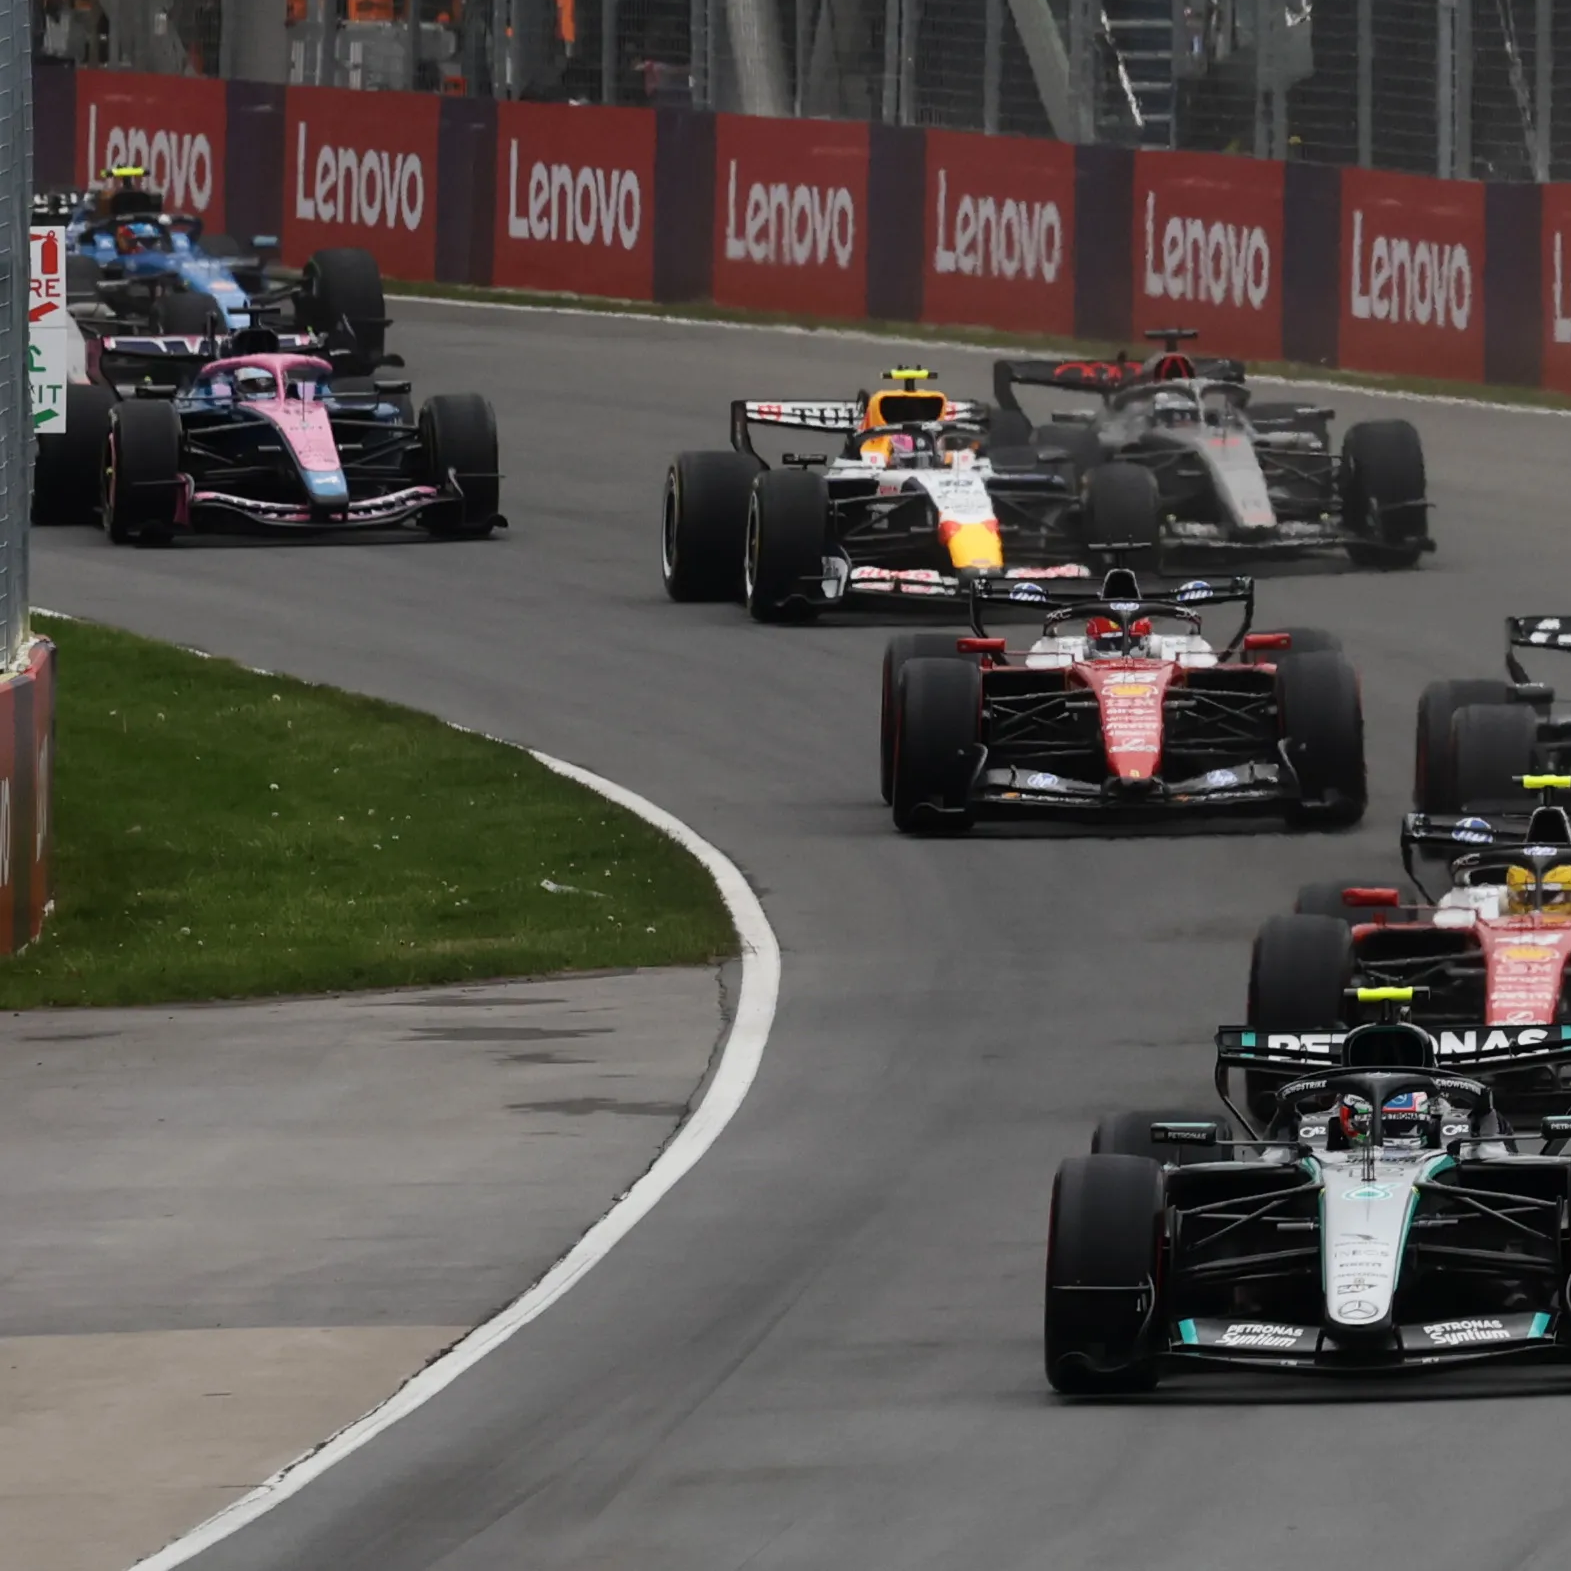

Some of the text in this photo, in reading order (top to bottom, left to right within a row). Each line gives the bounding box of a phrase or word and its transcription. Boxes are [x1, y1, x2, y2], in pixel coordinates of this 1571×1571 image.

[296, 121, 424, 231] Lenovo
[508, 139, 641, 250] Lenovo
[726, 160, 854, 268] Lenovo
[935, 169, 1062, 283] Lenovo
[1145, 191, 1270, 309] Lenovo
[1351, 210, 1472, 330] Lenovo
[1167, 1131, 1207, 1140] PETRONAS
[1214, 1332, 1297, 1348] Syntium
[1226, 1324, 1304, 1337] PETRONAS
[1423, 1319, 1503, 1335] PETRONAS
[1430, 1328, 1511, 1345] Syntium
